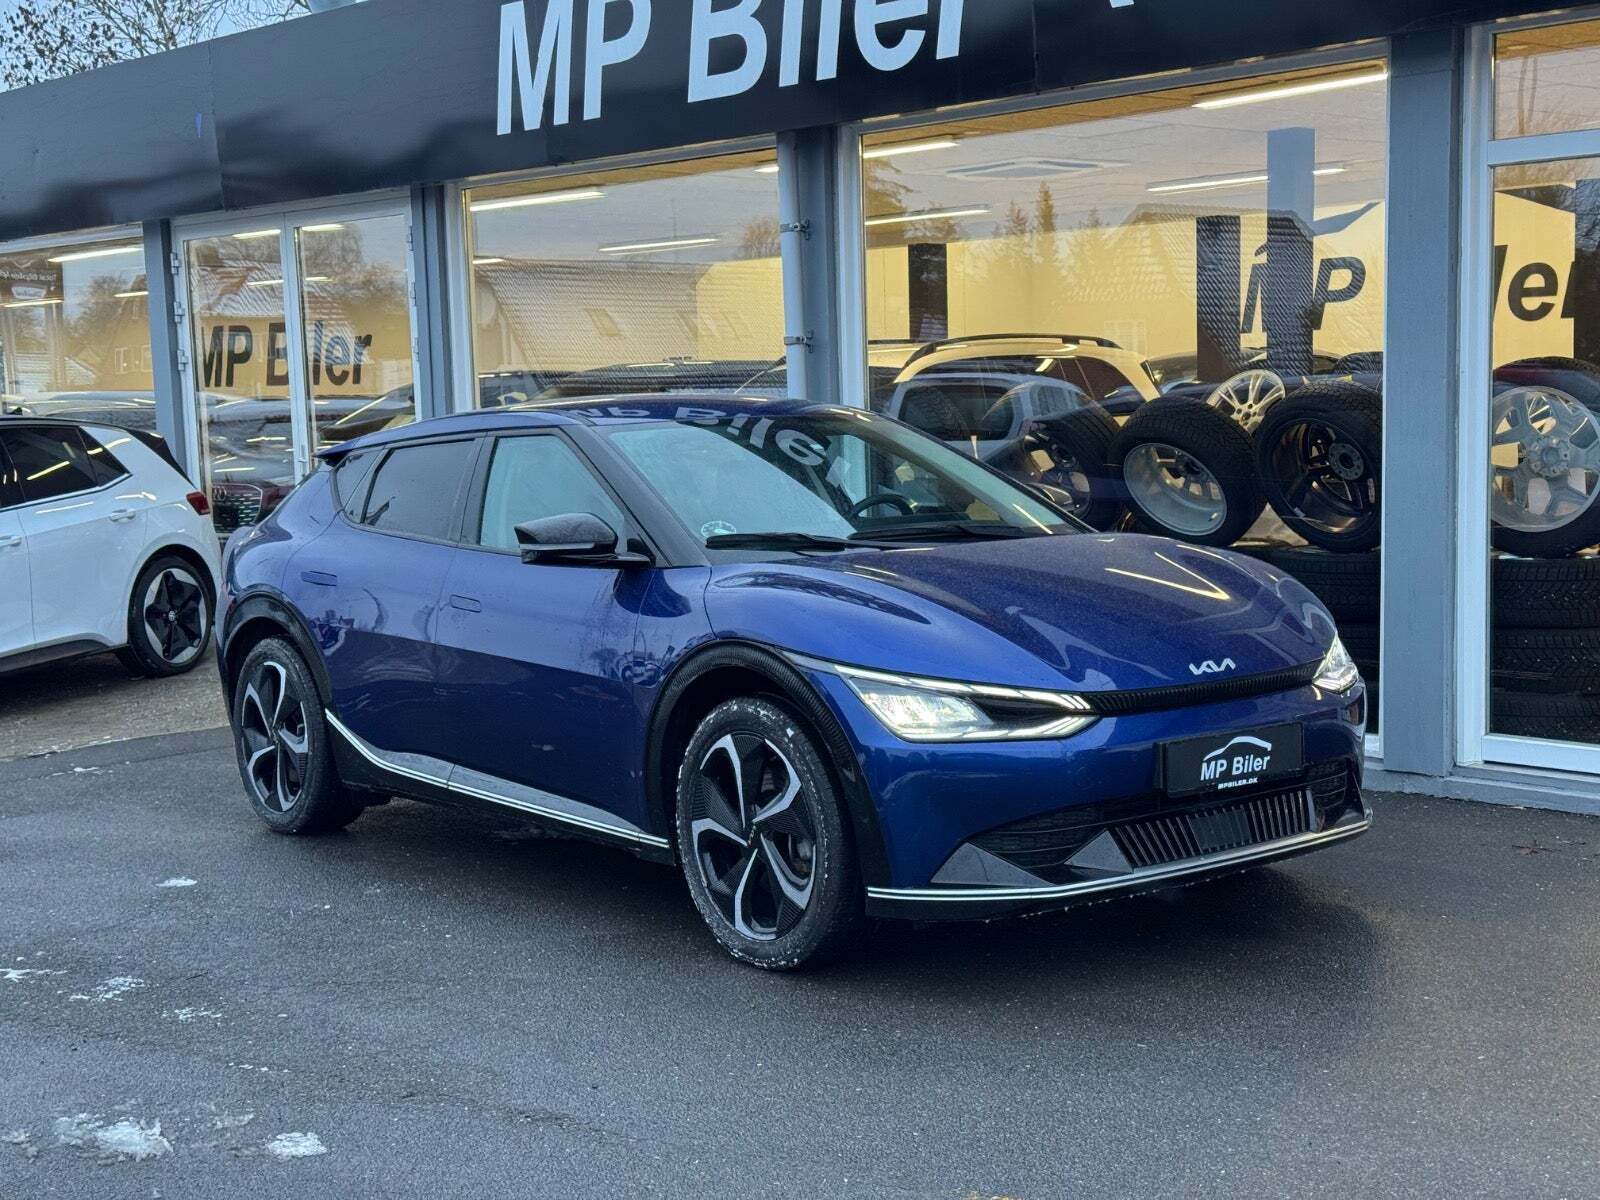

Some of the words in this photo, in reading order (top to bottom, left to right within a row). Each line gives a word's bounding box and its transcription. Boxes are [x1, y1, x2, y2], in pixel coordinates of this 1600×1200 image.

[497, 0, 652, 135] MP
[201, 325, 254, 388] MP
[1200, 759, 1227, 781] MP
[1231, 754, 1271, 775] Biler
